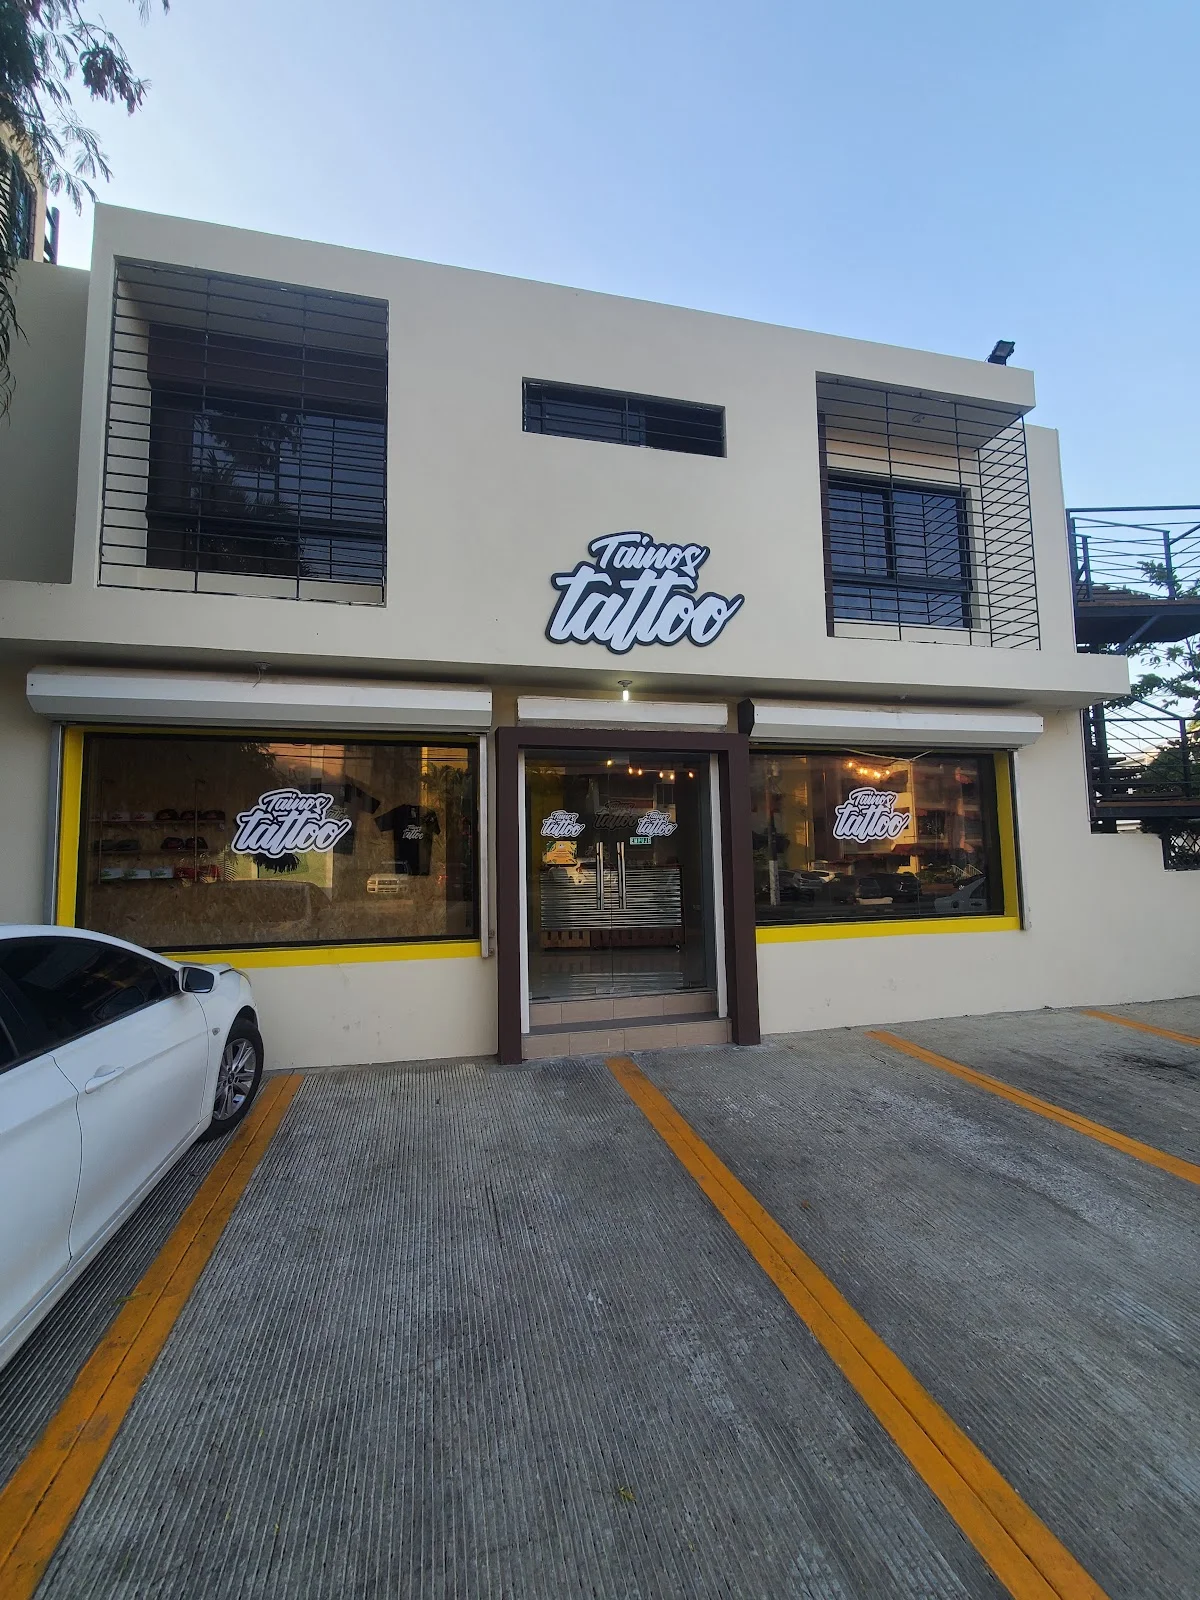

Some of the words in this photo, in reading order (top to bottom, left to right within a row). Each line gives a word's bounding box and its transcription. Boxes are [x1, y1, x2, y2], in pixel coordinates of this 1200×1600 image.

[590, 532, 707, 577] Tainos
[550, 564, 743, 651] tattoo
[262, 791, 331, 814] Tainos
[851, 790, 897, 808] Tainos
[234, 810, 349, 854] tattoo
[542, 818, 585, 837] tattoo
[636, 818, 677, 836] tattoo
[835, 803, 910, 839] tattoo
